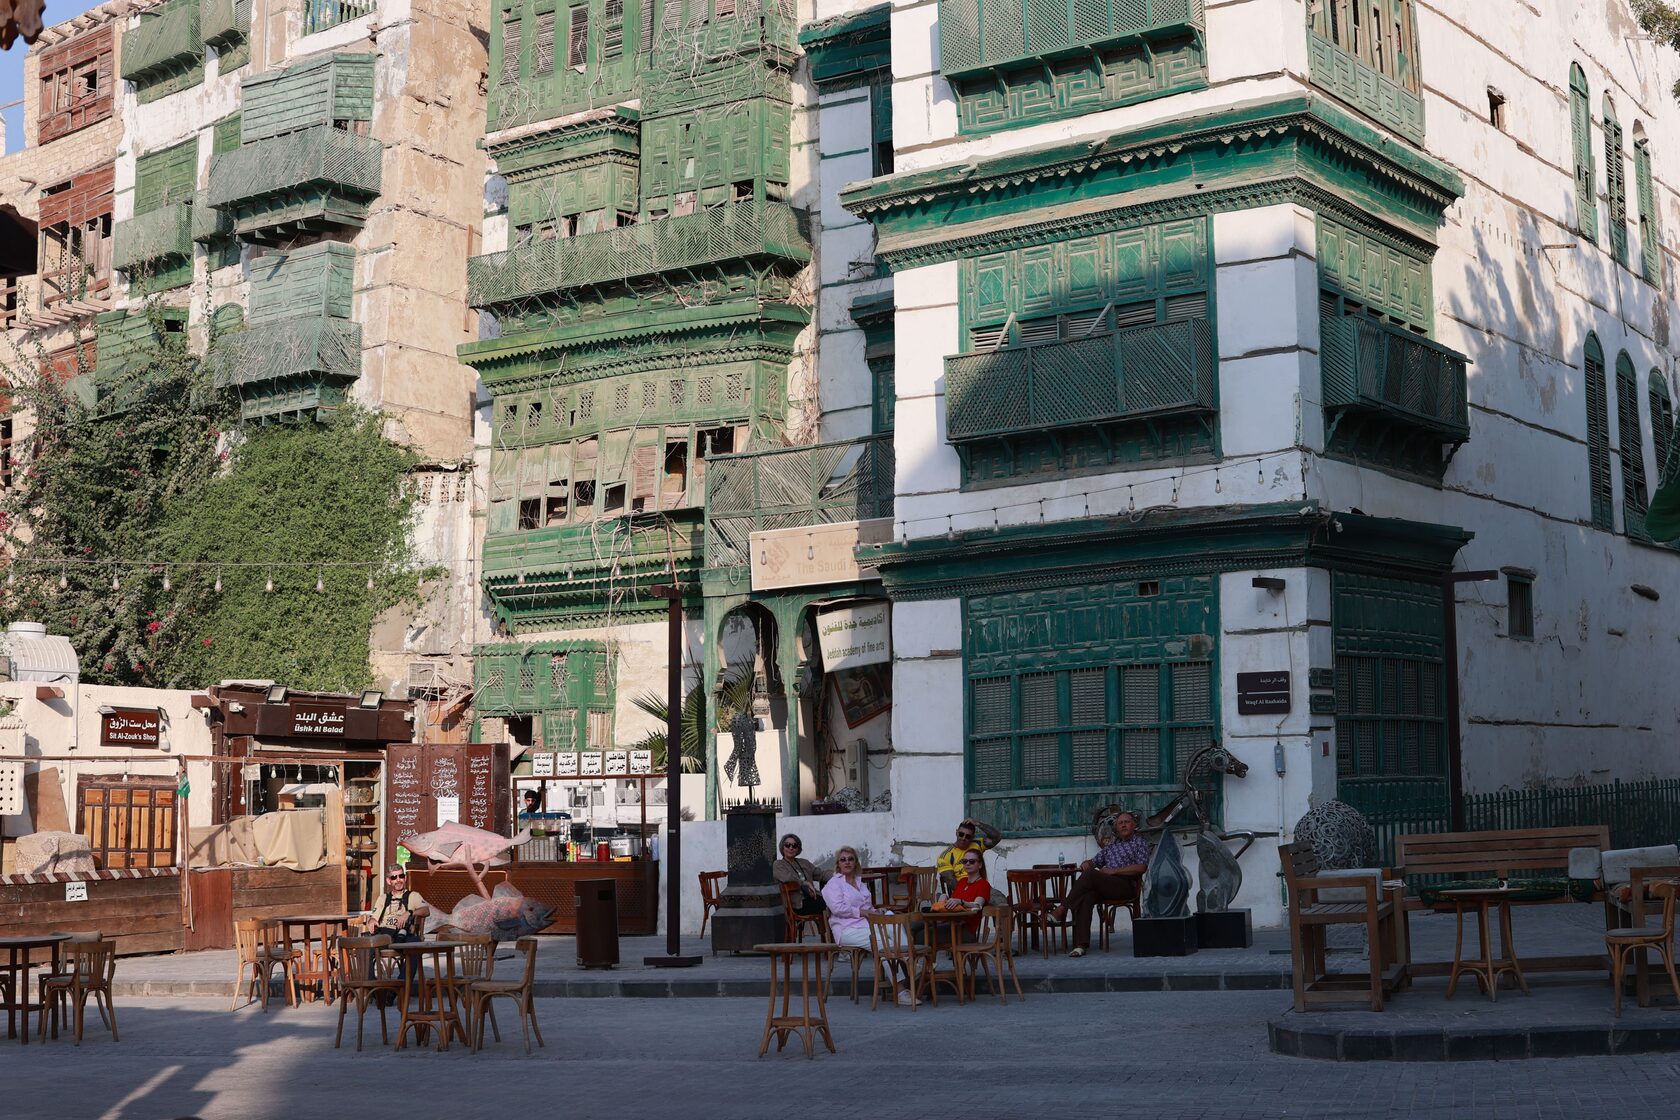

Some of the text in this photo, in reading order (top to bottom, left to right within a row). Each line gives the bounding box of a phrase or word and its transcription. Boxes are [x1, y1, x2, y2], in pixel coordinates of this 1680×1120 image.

[818, 559, 847, 573] Saudi
[844, 619, 857, 631] جدة
[827, 641, 885, 660] Jeddah academy of fine arts
[295, 711, 344, 724] عشق البلد
[129, 719, 141, 728] ست
[141, 719, 157, 730] محل
[322, 726, 344, 734] Balad
[109, 732, 157, 742] Sit Al-Zouk's Shop
[606, 753, 626, 762] بطاطس
